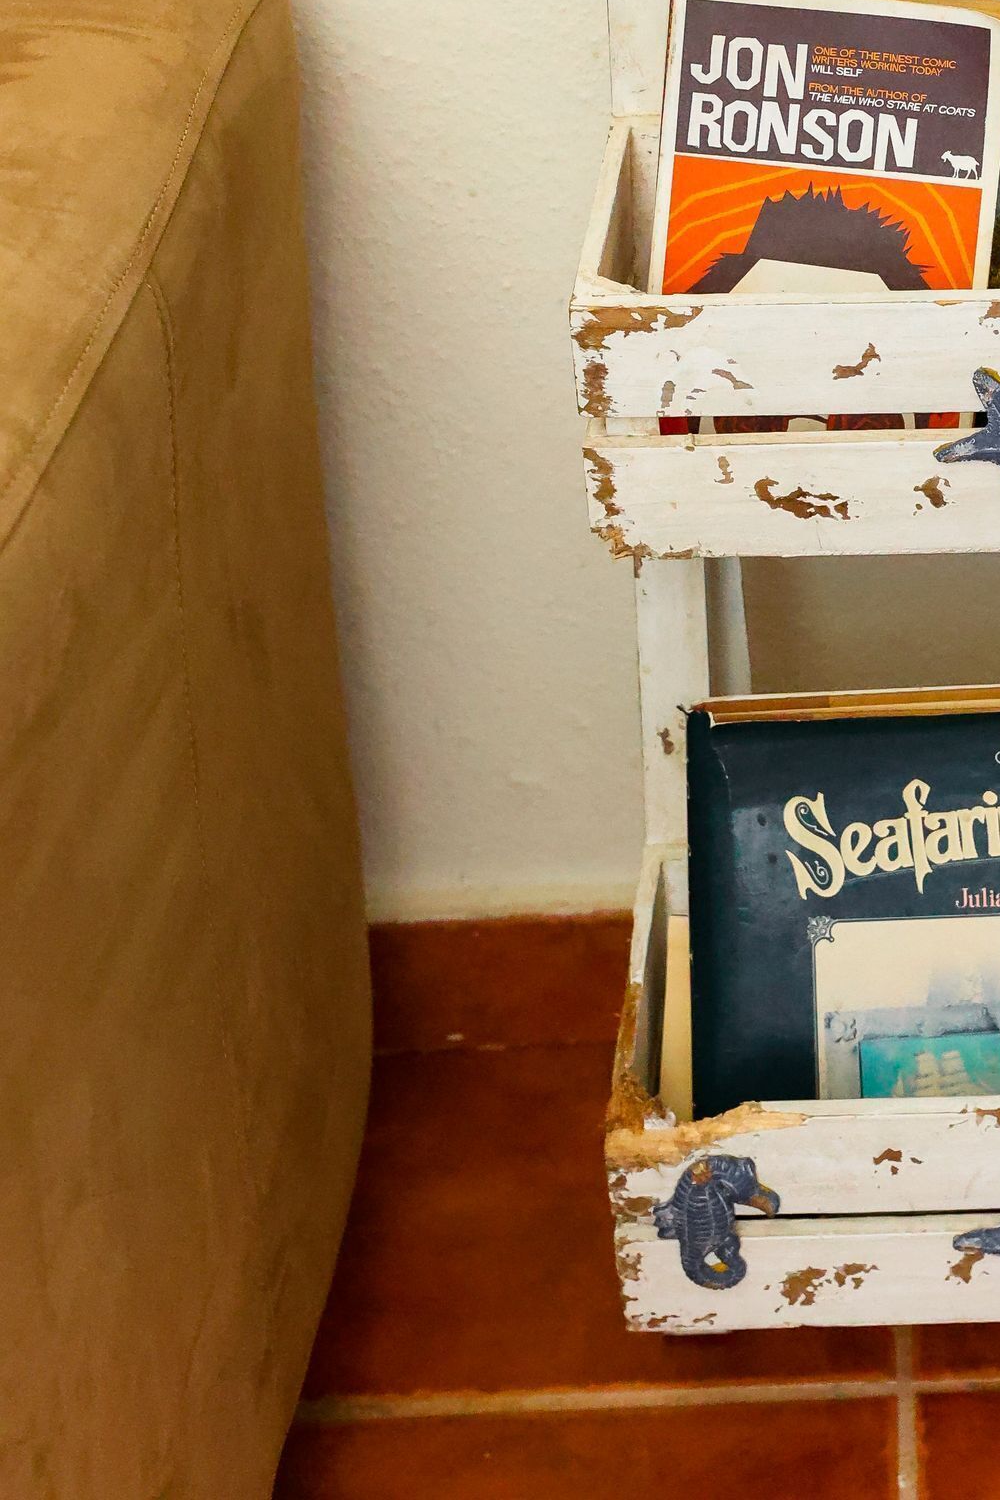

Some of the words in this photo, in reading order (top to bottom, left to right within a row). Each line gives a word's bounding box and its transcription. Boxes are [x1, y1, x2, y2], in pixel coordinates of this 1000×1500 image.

[690, 34, 808, 100] JON
[811, 54, 858, 68] WRITERS
[860, 59, 907, 73] WORKING
[909, 64, 943, 77] TODAY
[813, 45, 838, 57] ONE
[839, 48, 856, 58] OF
[858, 49, 881, 61] THE
[882, 51, 920, 65] FINEST
[922, 56, 957, 69] COMIC
[811, 64, 834, 75] WILL
[836, 67, 863, 78] SELF
[808, 82, 839, 94] FROM
[841, 85, 864, 97] THE
[866, 87, 908, 101] AUTHOR
[911, 93, 927, 102] OF
[809, 91, 832, 102] THE
[834, 94, 856, 105] MEN
[858, 97, 884, 108] WHO
[886, 100, 921, 112] STARE
[923, 103, 938, 113] AT
[687, 91, 919, 172] RONSON
